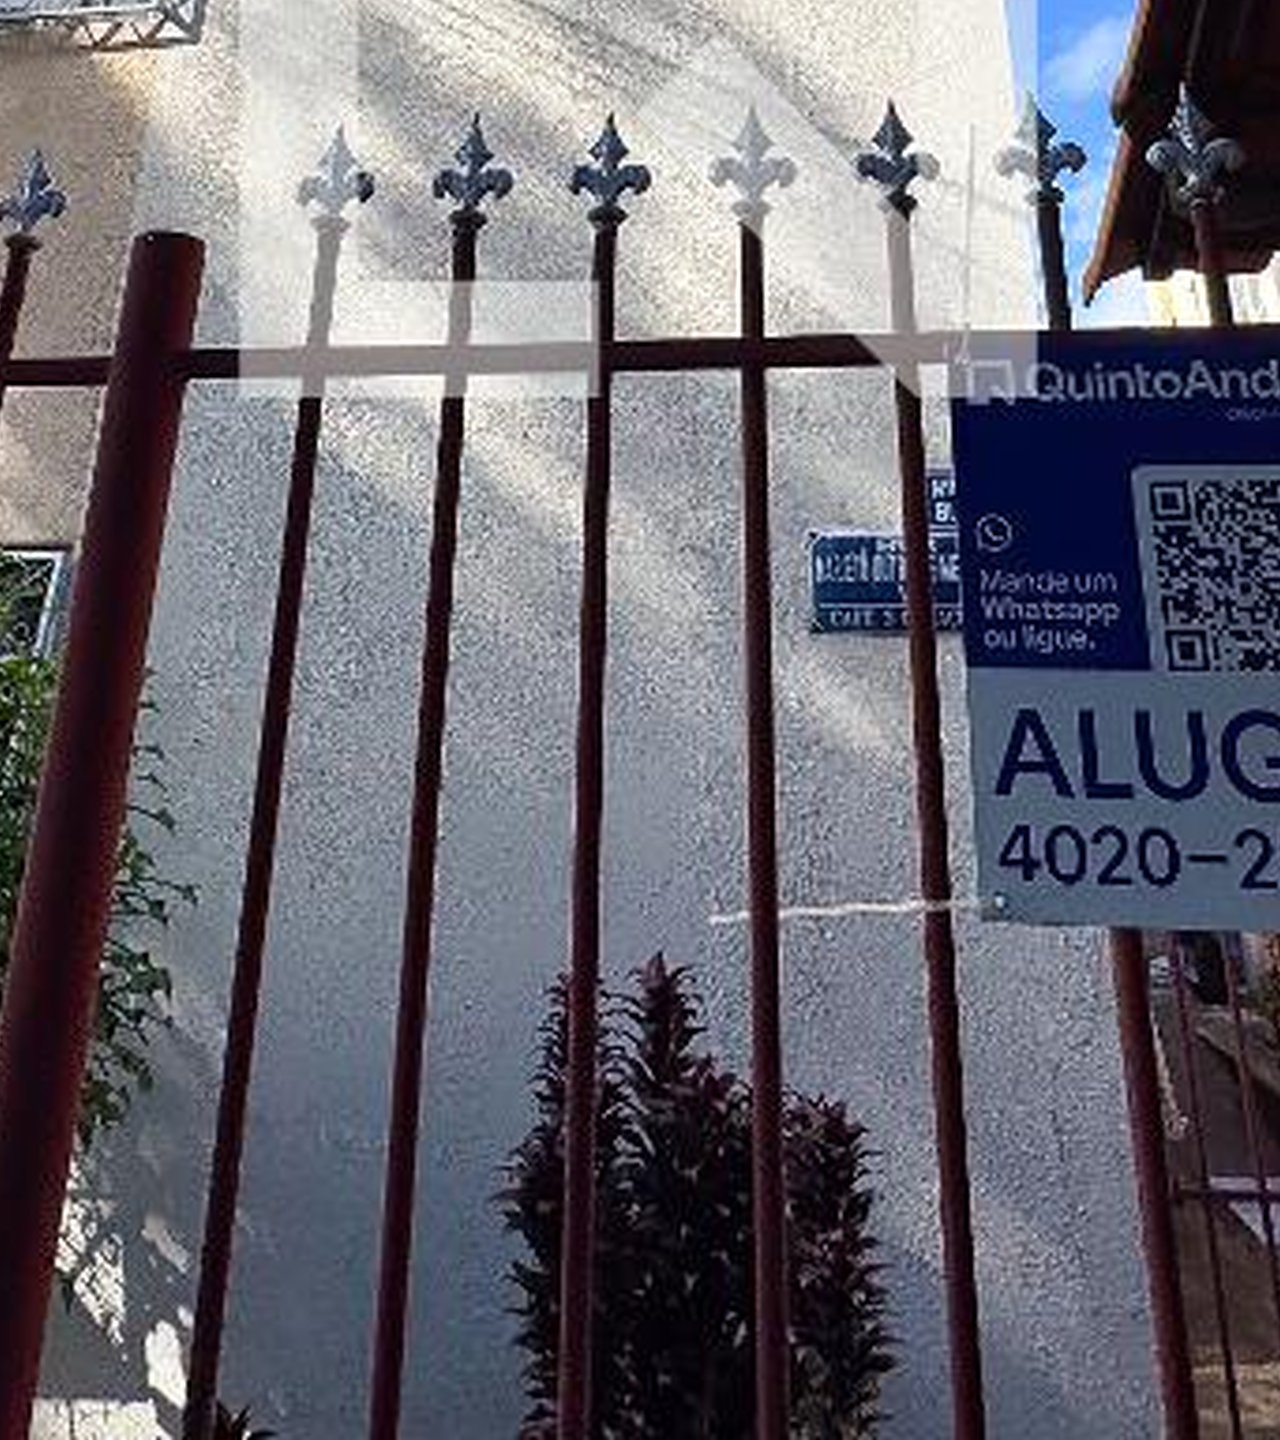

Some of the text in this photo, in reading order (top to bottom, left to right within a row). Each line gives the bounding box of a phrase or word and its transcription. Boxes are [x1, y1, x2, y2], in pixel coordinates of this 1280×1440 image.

[979, 568, 1118, 594] Mande um
[979, 594, 1121, 628] Whatsapp
[983, 628, 1017, 650] ou
